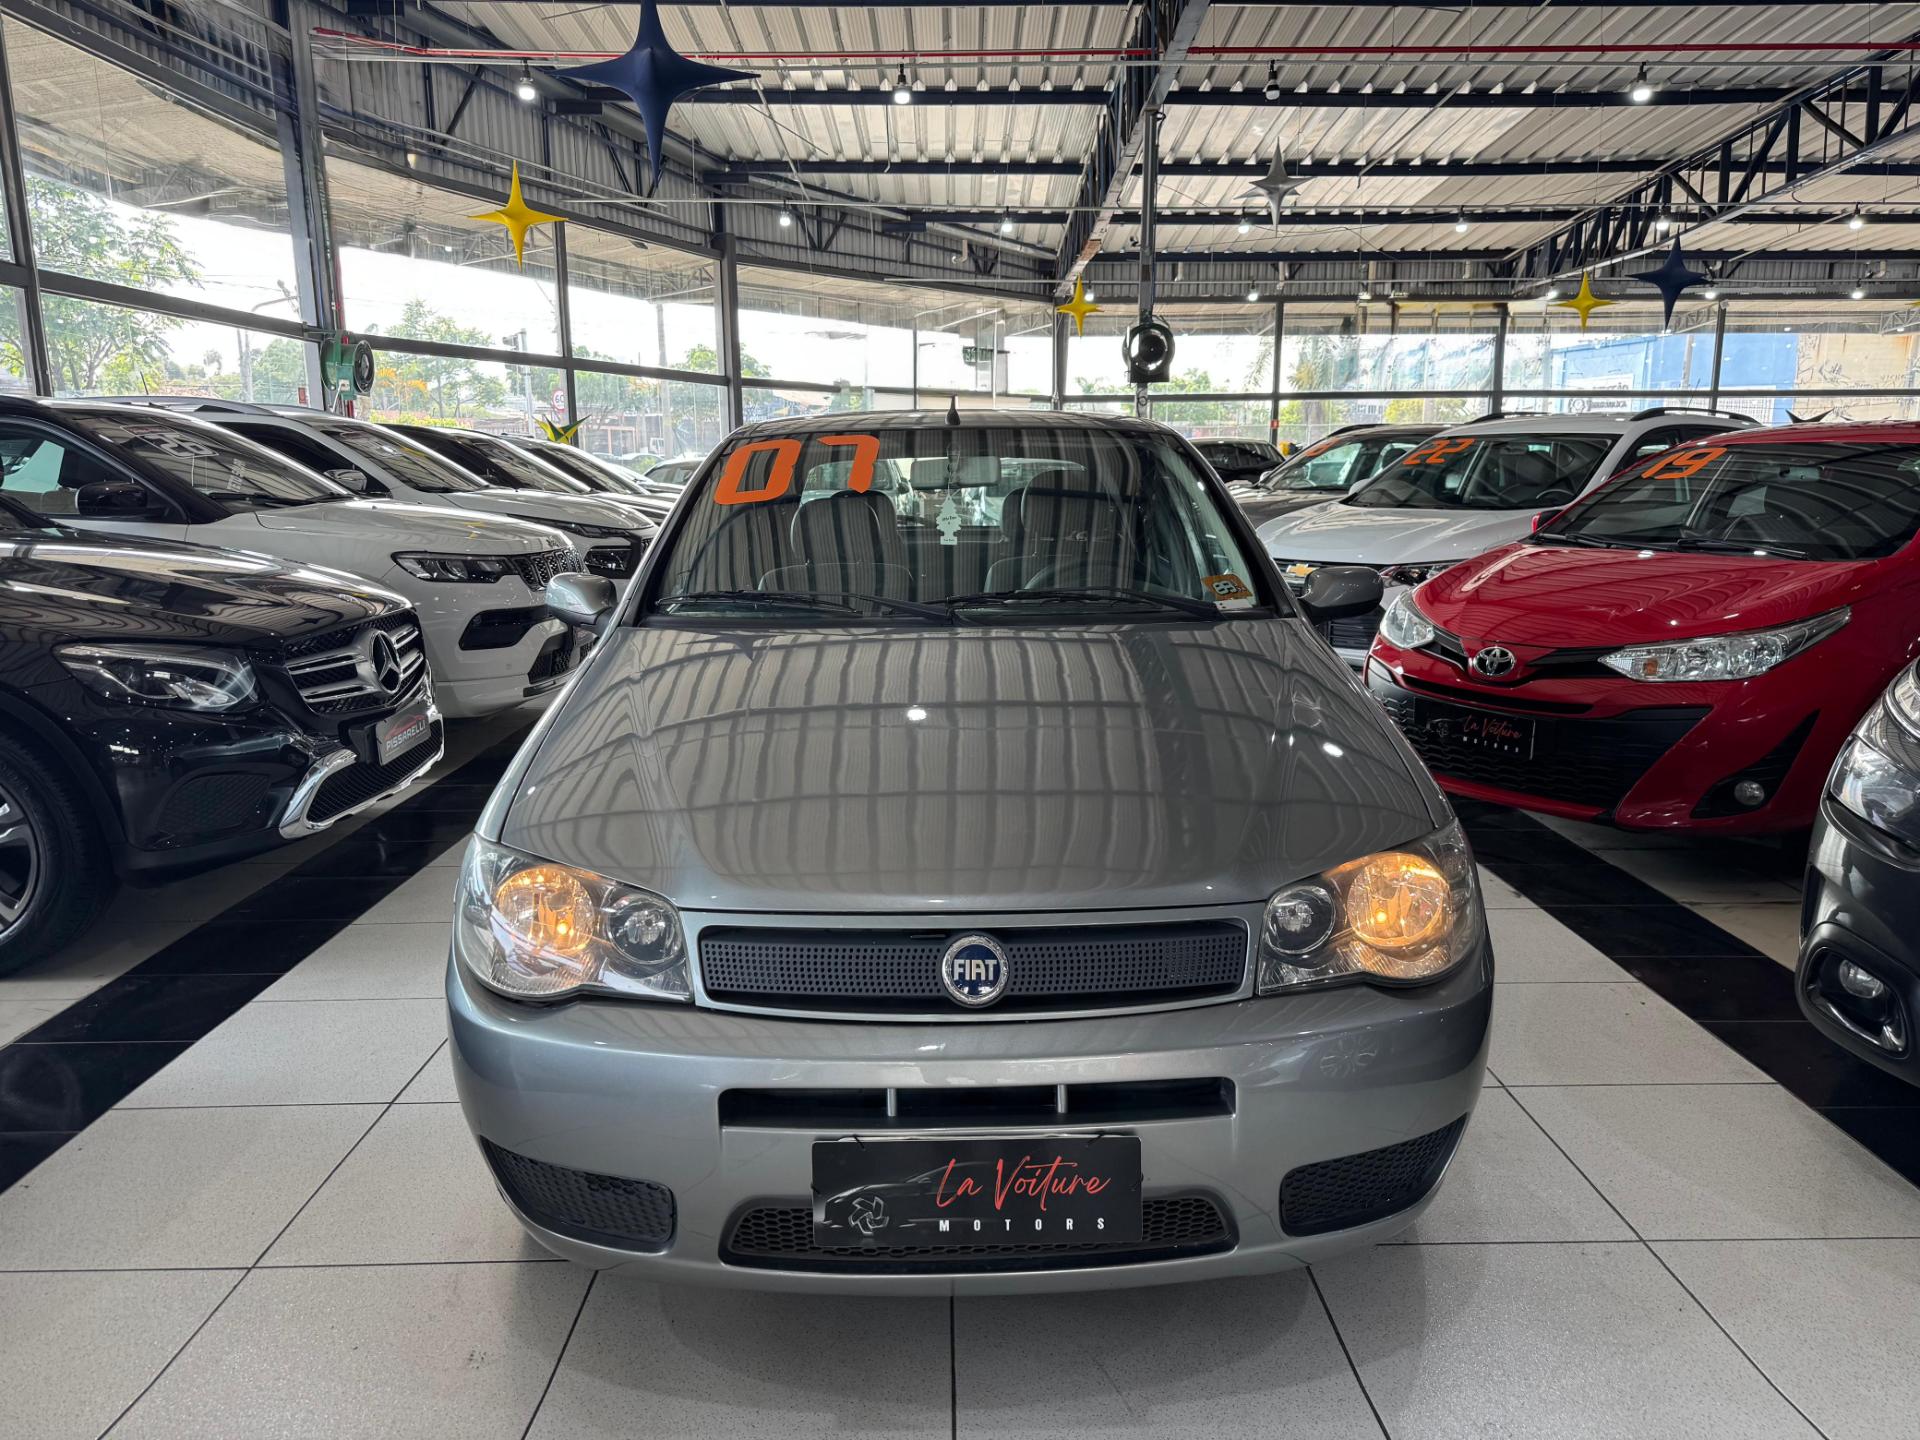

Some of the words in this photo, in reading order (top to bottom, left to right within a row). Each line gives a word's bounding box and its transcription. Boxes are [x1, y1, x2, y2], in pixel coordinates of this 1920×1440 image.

[1403, 438, 1475, 464] 22
[1641, 447, 1728, 480] 19
[714, 435, 880, 505] 07
[386, 720, 426, 751] PISSARELLI
[953, 959, 997, 981] FIAT
[935, 1158, 983, 1208] La
[994, 1155, 1111, 1212] Voiture
[939, 1217, 1106, 1232] MOTORS
